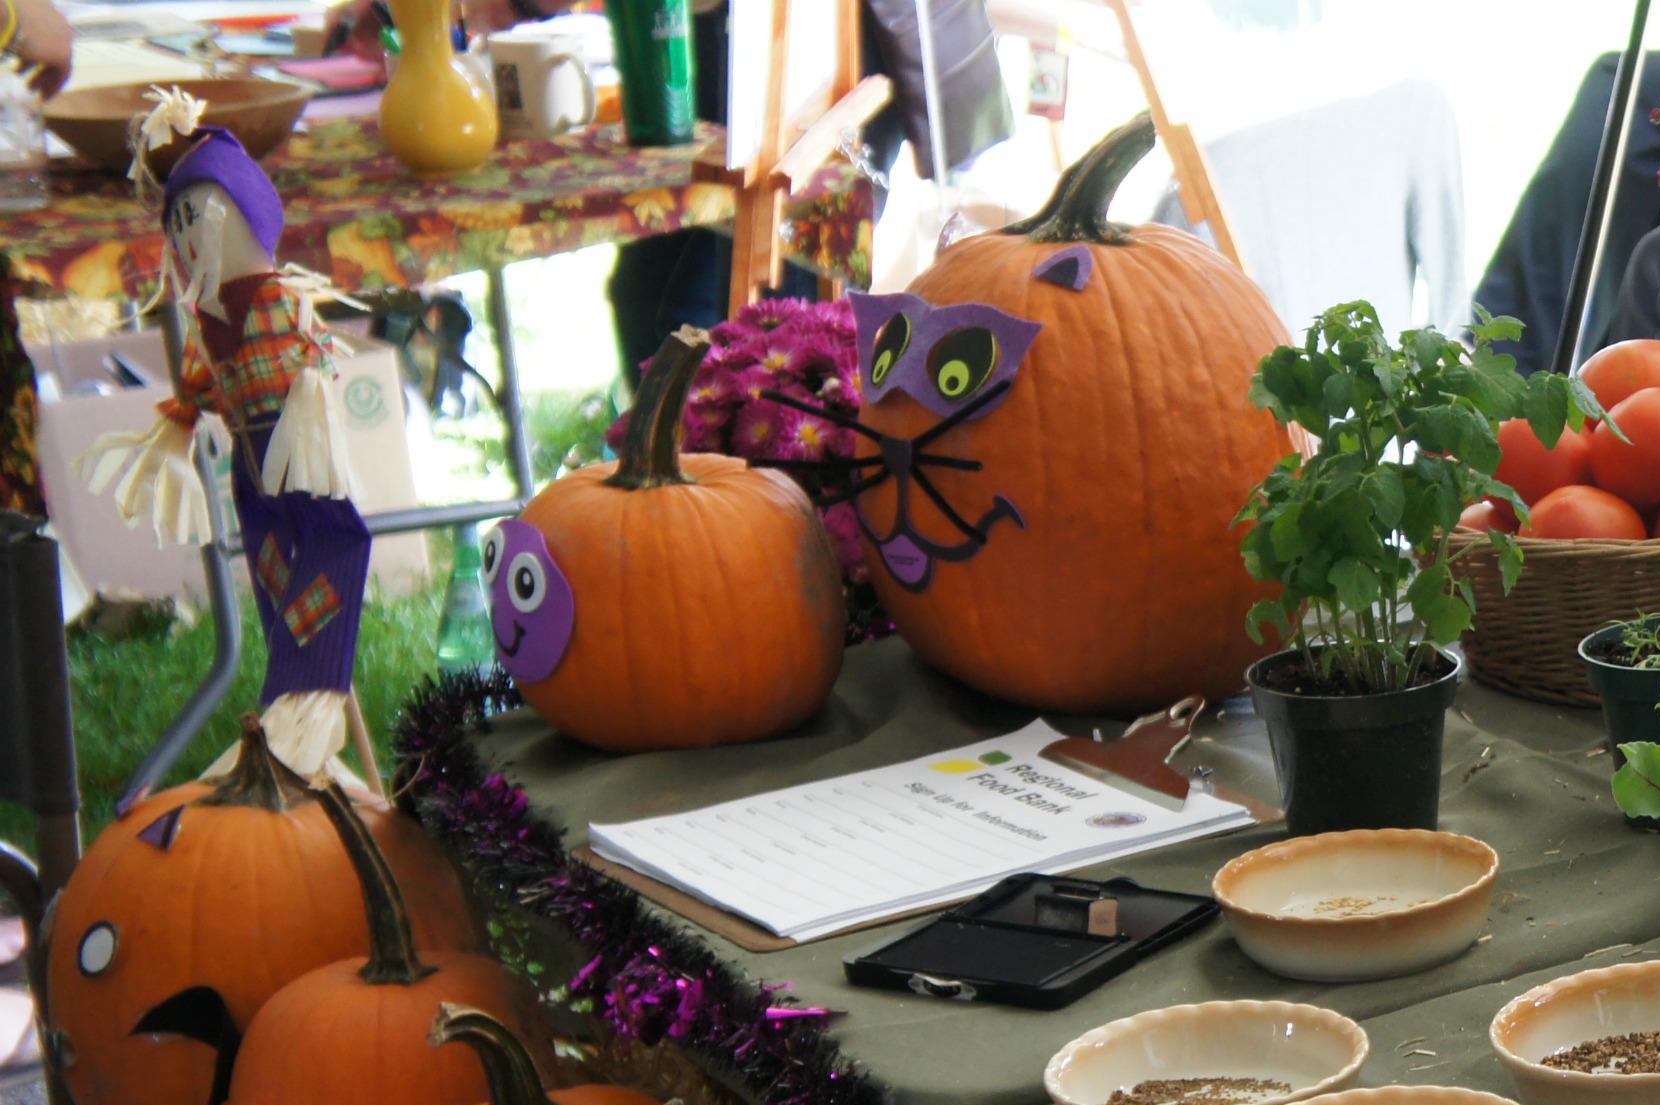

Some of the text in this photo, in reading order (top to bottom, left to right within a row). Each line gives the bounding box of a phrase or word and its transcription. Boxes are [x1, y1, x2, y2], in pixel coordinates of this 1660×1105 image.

[966, 772, 1073, 816] Food Bank
[1005, 763, 1100, 801] Regional
[904, 781, 937, 798] Sign
[932, 790, 956, 806] Up
[951, 798, 976, 813] for
[973, 810, 1049, 842] Information
